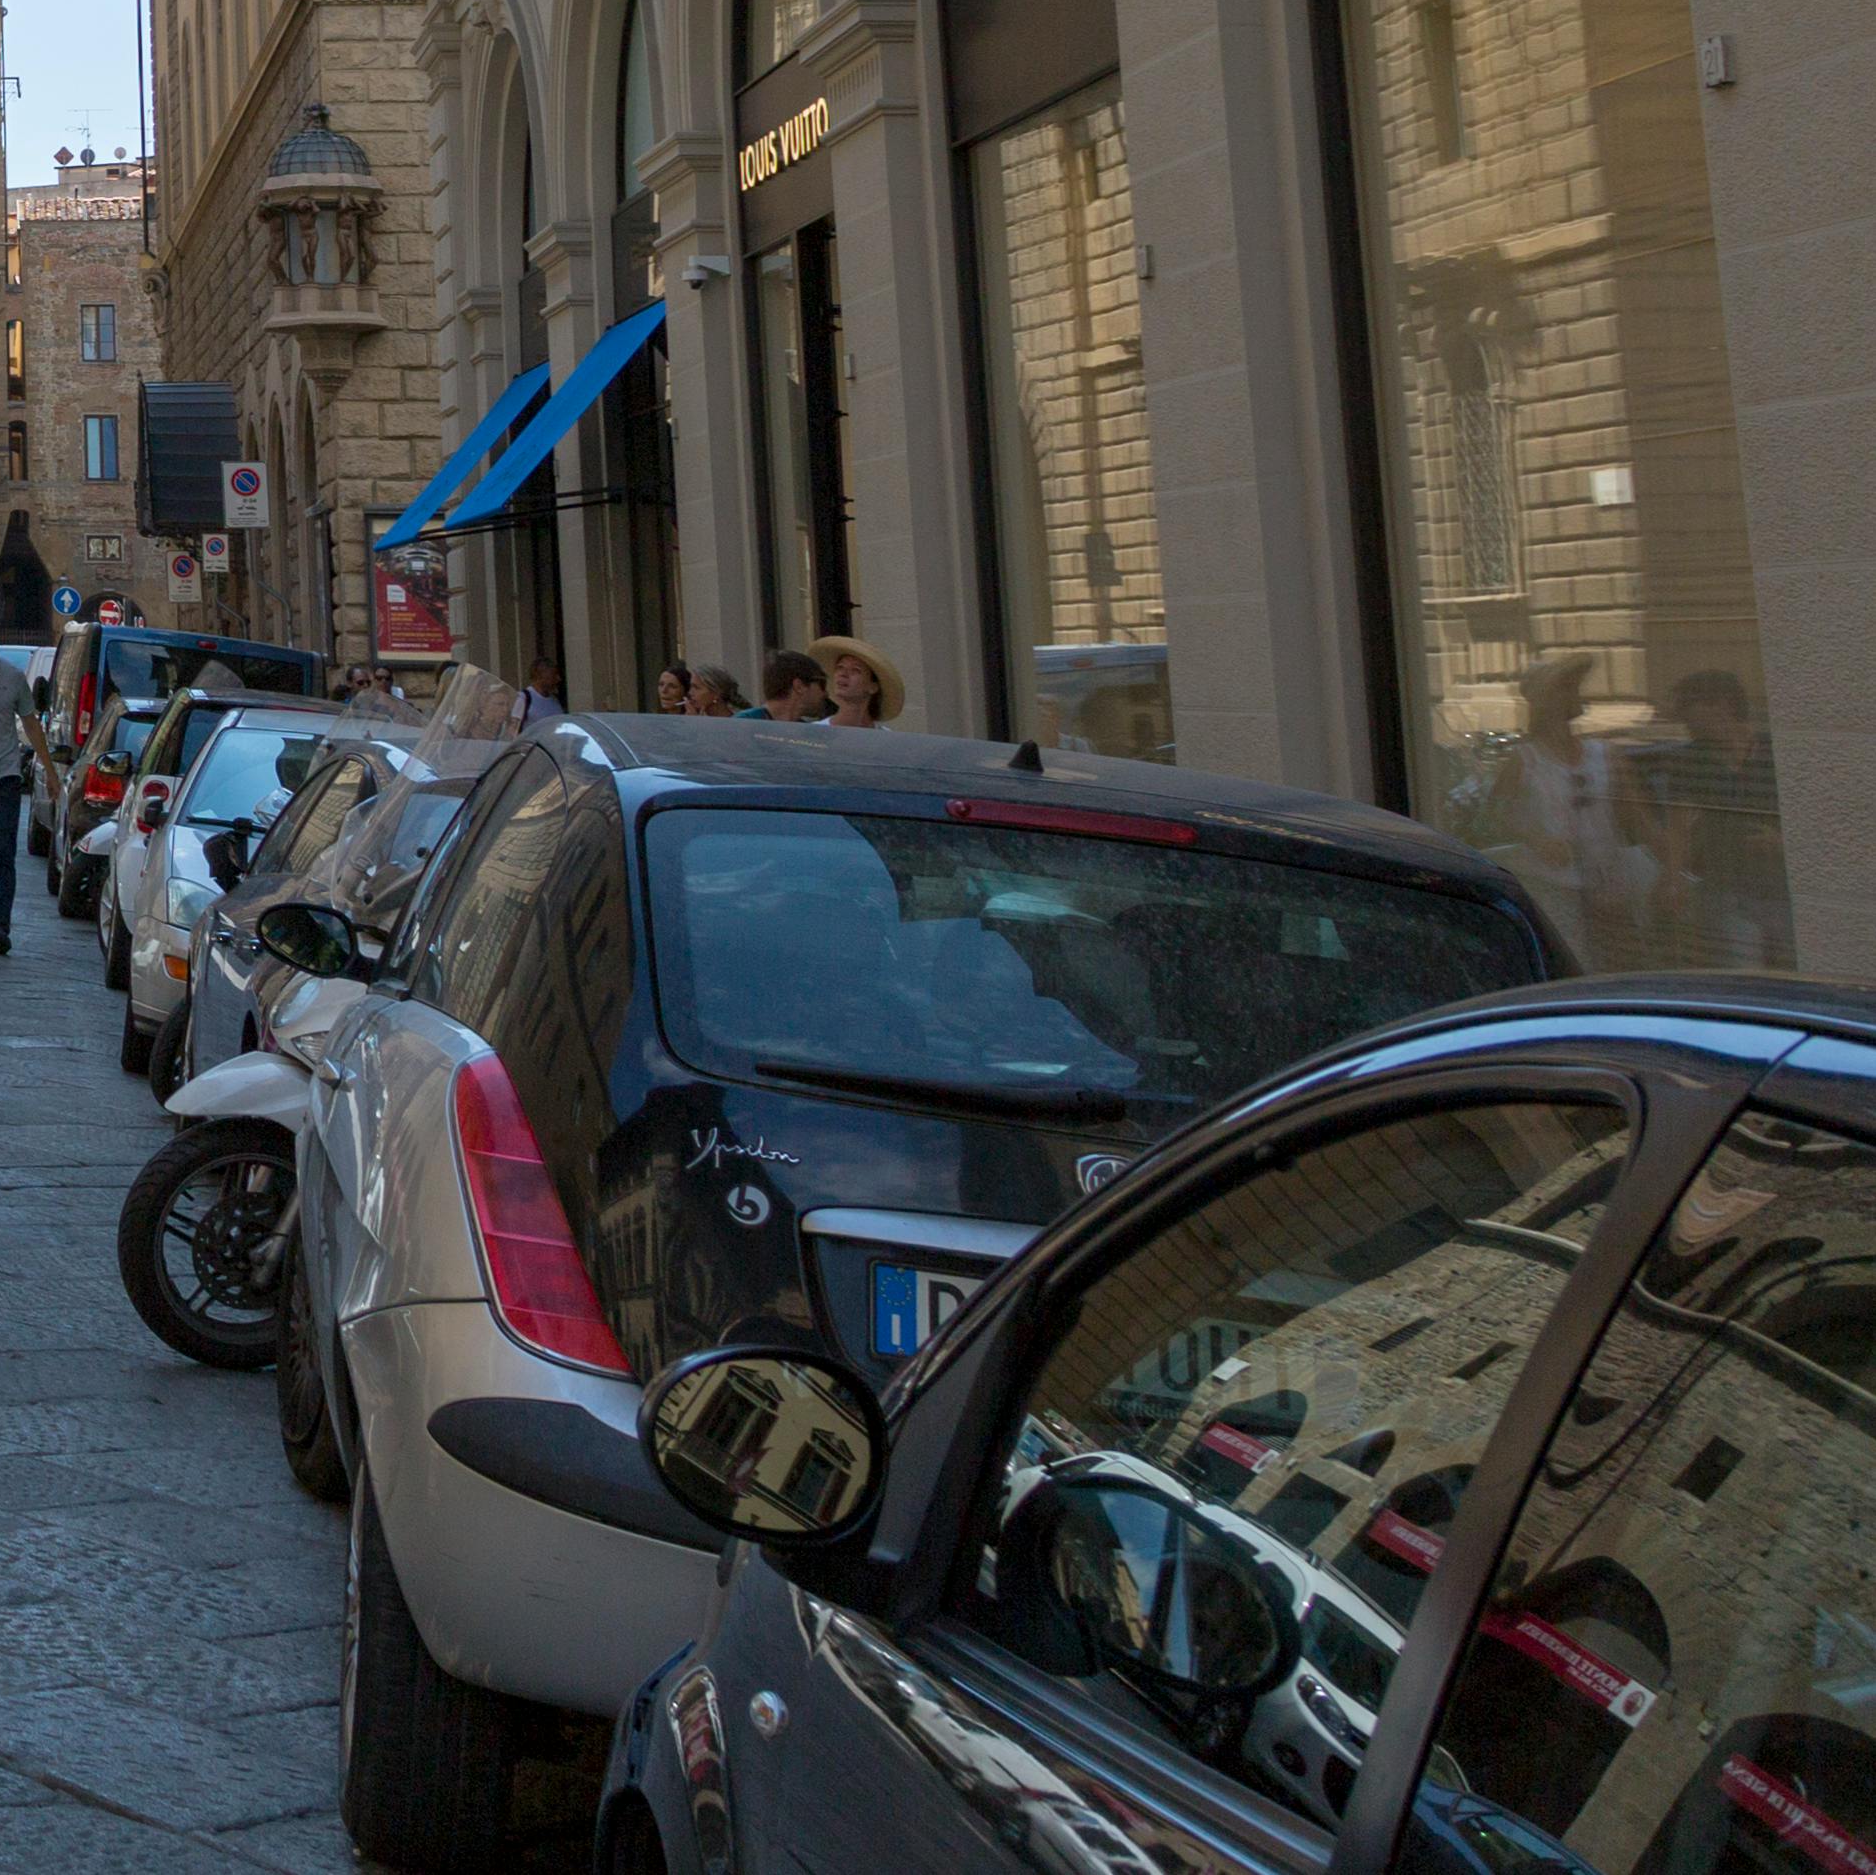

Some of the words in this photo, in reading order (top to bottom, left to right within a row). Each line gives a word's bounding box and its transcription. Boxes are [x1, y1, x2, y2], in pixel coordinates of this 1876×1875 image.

[739, 130, 778, 191] LOUIS
[779, 97, 829, 166] VUITTO
[686, 1127, 800, 1169] Ypsilon
